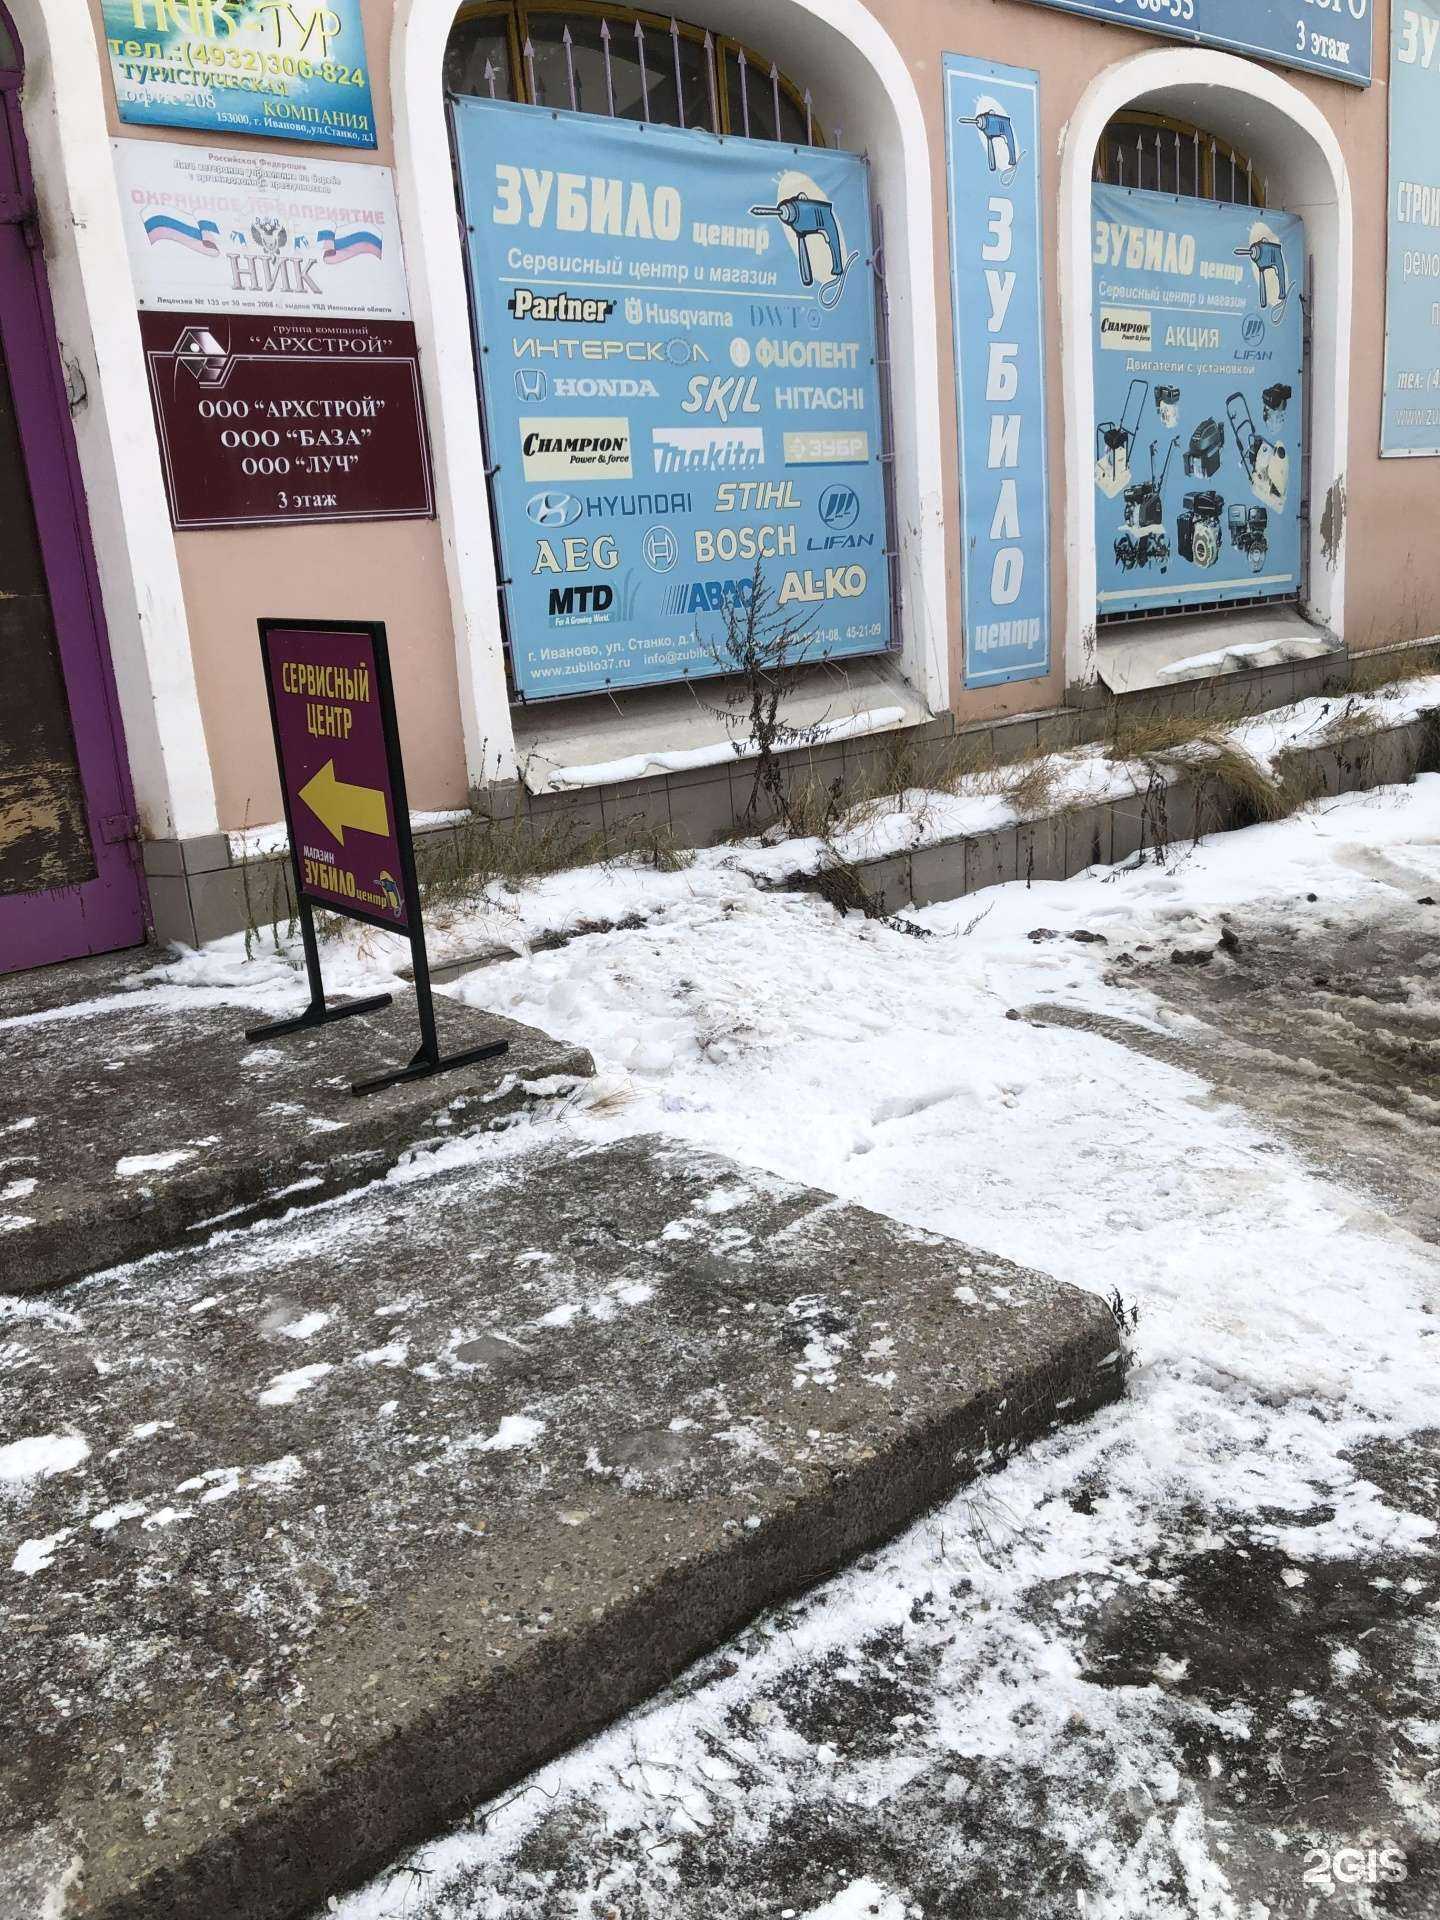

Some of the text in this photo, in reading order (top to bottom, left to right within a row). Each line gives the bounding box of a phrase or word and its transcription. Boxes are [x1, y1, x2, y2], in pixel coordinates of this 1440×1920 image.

[1296, 19, 1350, 64] 3 этаж
[118, 63, 289, 97] ТУРИСТИЧЕСКАЯ
[183, 91, 216, 109] 208
[263, 101, 369, 130] КОМПАНИЯ
[493, 164, 770, 255] ЗУБИЛО центр
[1093, 220, 1244, 285] ЗУБИЛО центр
[226, 252, 323, 294] НИК
[507, 248, 777, 286] Сервисный центр и магазин
[513, 288, 608, 323] Partner
[1098, 280, 1160, 300] Сервисный
[1162, 289, 1197, 306] центр
[1206, 294, 1247, 307] магазин
[272, 324, 369, 336] группа компаний
[644, 302, 734, 330] Husqvarna
[750, 304, 801, 329] DWT
[511, 337, 711, 366] ИНТЕРСКОЛ
[1164, 326, 1221, 350] АКЦИЯ
[755, 337, 860, 369] ФИОЛЕНТ
[1126, 357, 1256, 376] Двигатели с установкой
[1233, 350, 1273, 360] LIFAN
[553, 378, 660, 398] HONDA
[681, 374, 762, 423] SKIL
[774, 387, 864, 410] HITACHI
[982, 196, 1024, 606] ЗУБИЛО
[198, 400, 249, 418] ООО
[220, 429, 280, 448] ООО
[809, 438, 864, 458] ЗУБР
[241, 457, 290, 475] ООО
[569, 455, 629, 465] Power & force
[278, 492, 338, 508] 3 этаж
[586, 493, 692, 518] HYUNDAI
[713, 480, 802, 513] STIHL
[531, 535, 620, 576] AEG
[694, 524, 798, 564] BOSCH
[806, 533, 875, 551] LIFAN
[778, 564, 868, 606] AL-KO
[549, 584, 613, 616] MTD
[528, 651, 537, 662] г.
[540, 645, 602, 661] Иваново,
[605, 641, 624, 656] ул.
[628, 634, 675, 651] Станко,
[975, 617, 1040, 654] центр
[282, 661, 370, 703] СЕРВИСНЫЙ
[530, 657, 631, 679] www.zubilo37.ru
[306, 703, 352, 740] ЦЕНТР
[303, 845, 335, 864] МАГАЗИН
[304, 859, 387, 909] ЗУБИЛО центр
